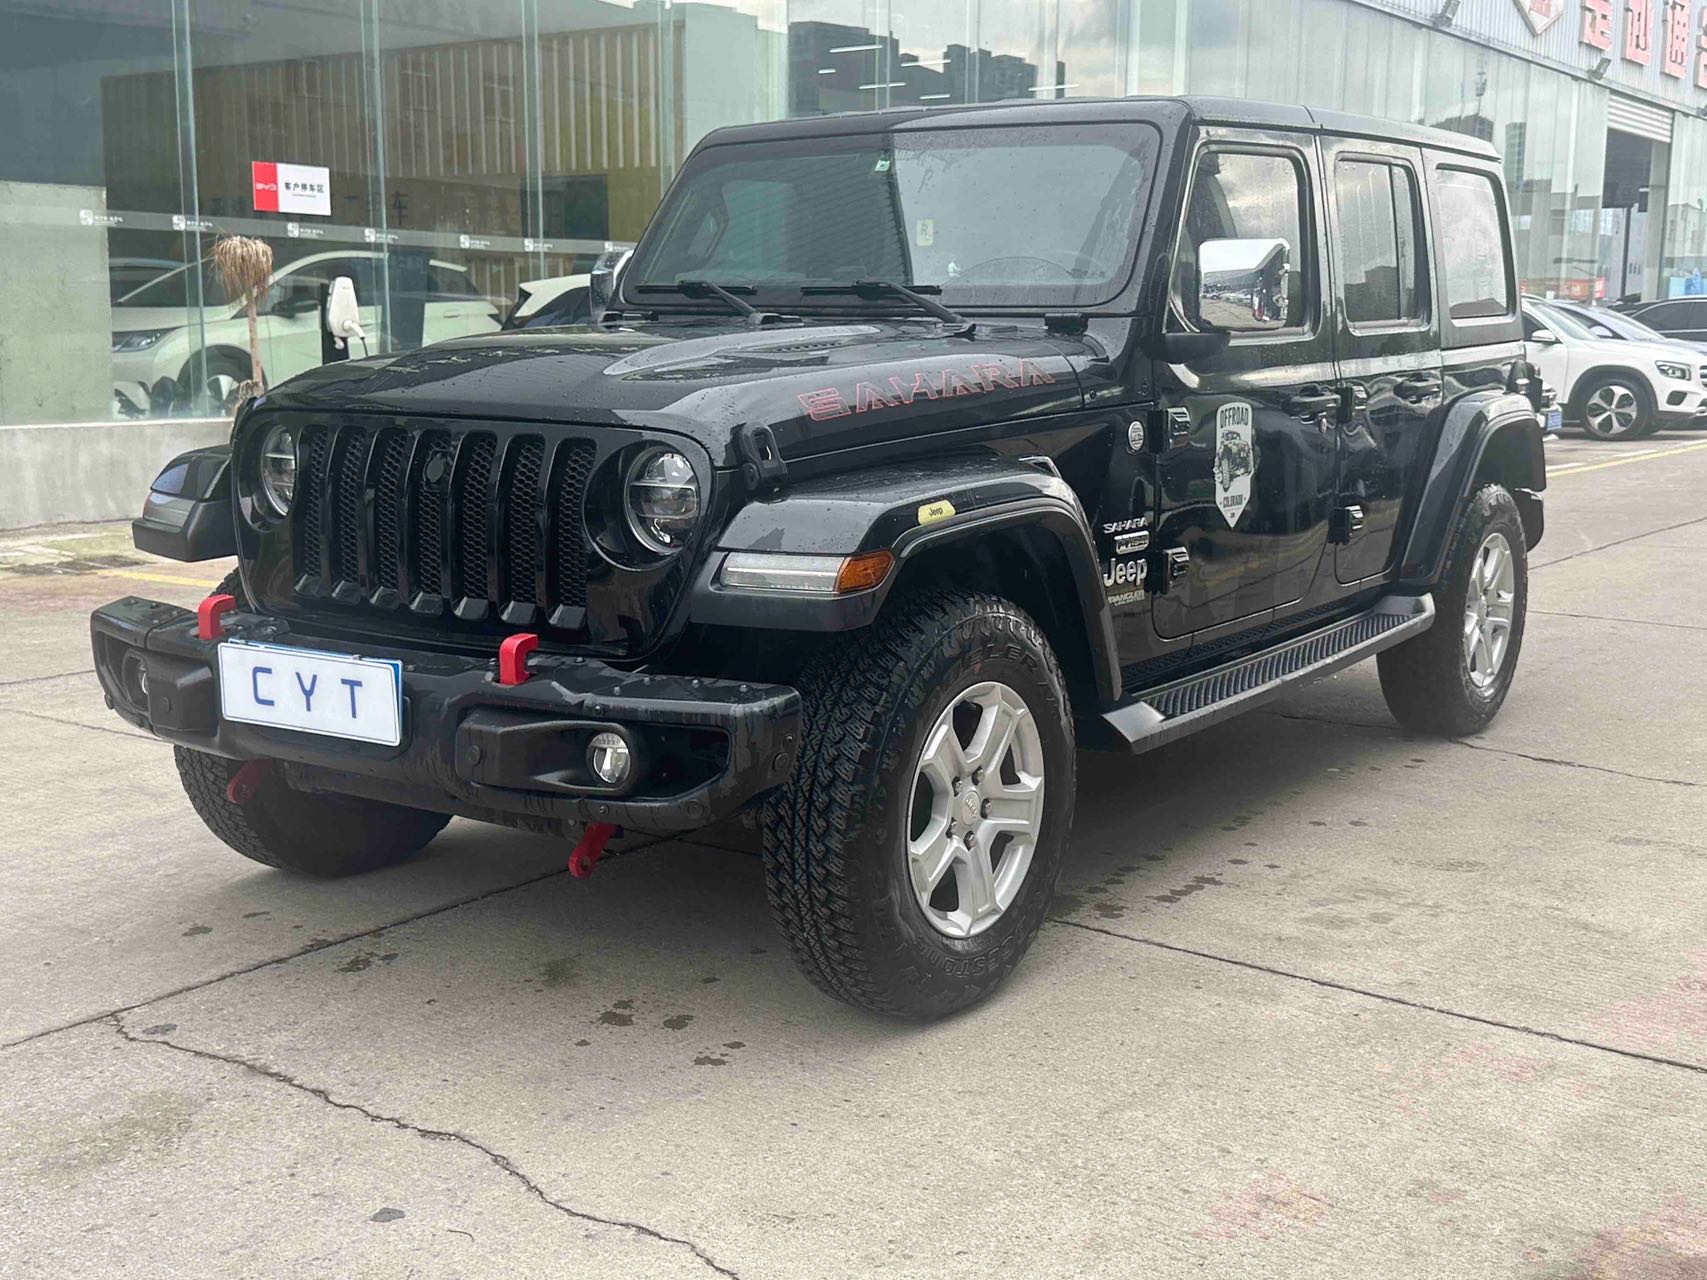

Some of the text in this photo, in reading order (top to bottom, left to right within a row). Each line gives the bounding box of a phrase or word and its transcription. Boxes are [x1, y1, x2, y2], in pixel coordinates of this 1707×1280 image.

[798, 358, 1055, 421] SAHARA
[1220, 407, 1249, 428] OFFROAD
[929, 507, 943, 517] Jeep
[1103, 517, 1149, 533] SAHARA
[1103, 558, 1148, 587] Jeep
[252, 666, 363, 718] CYT
